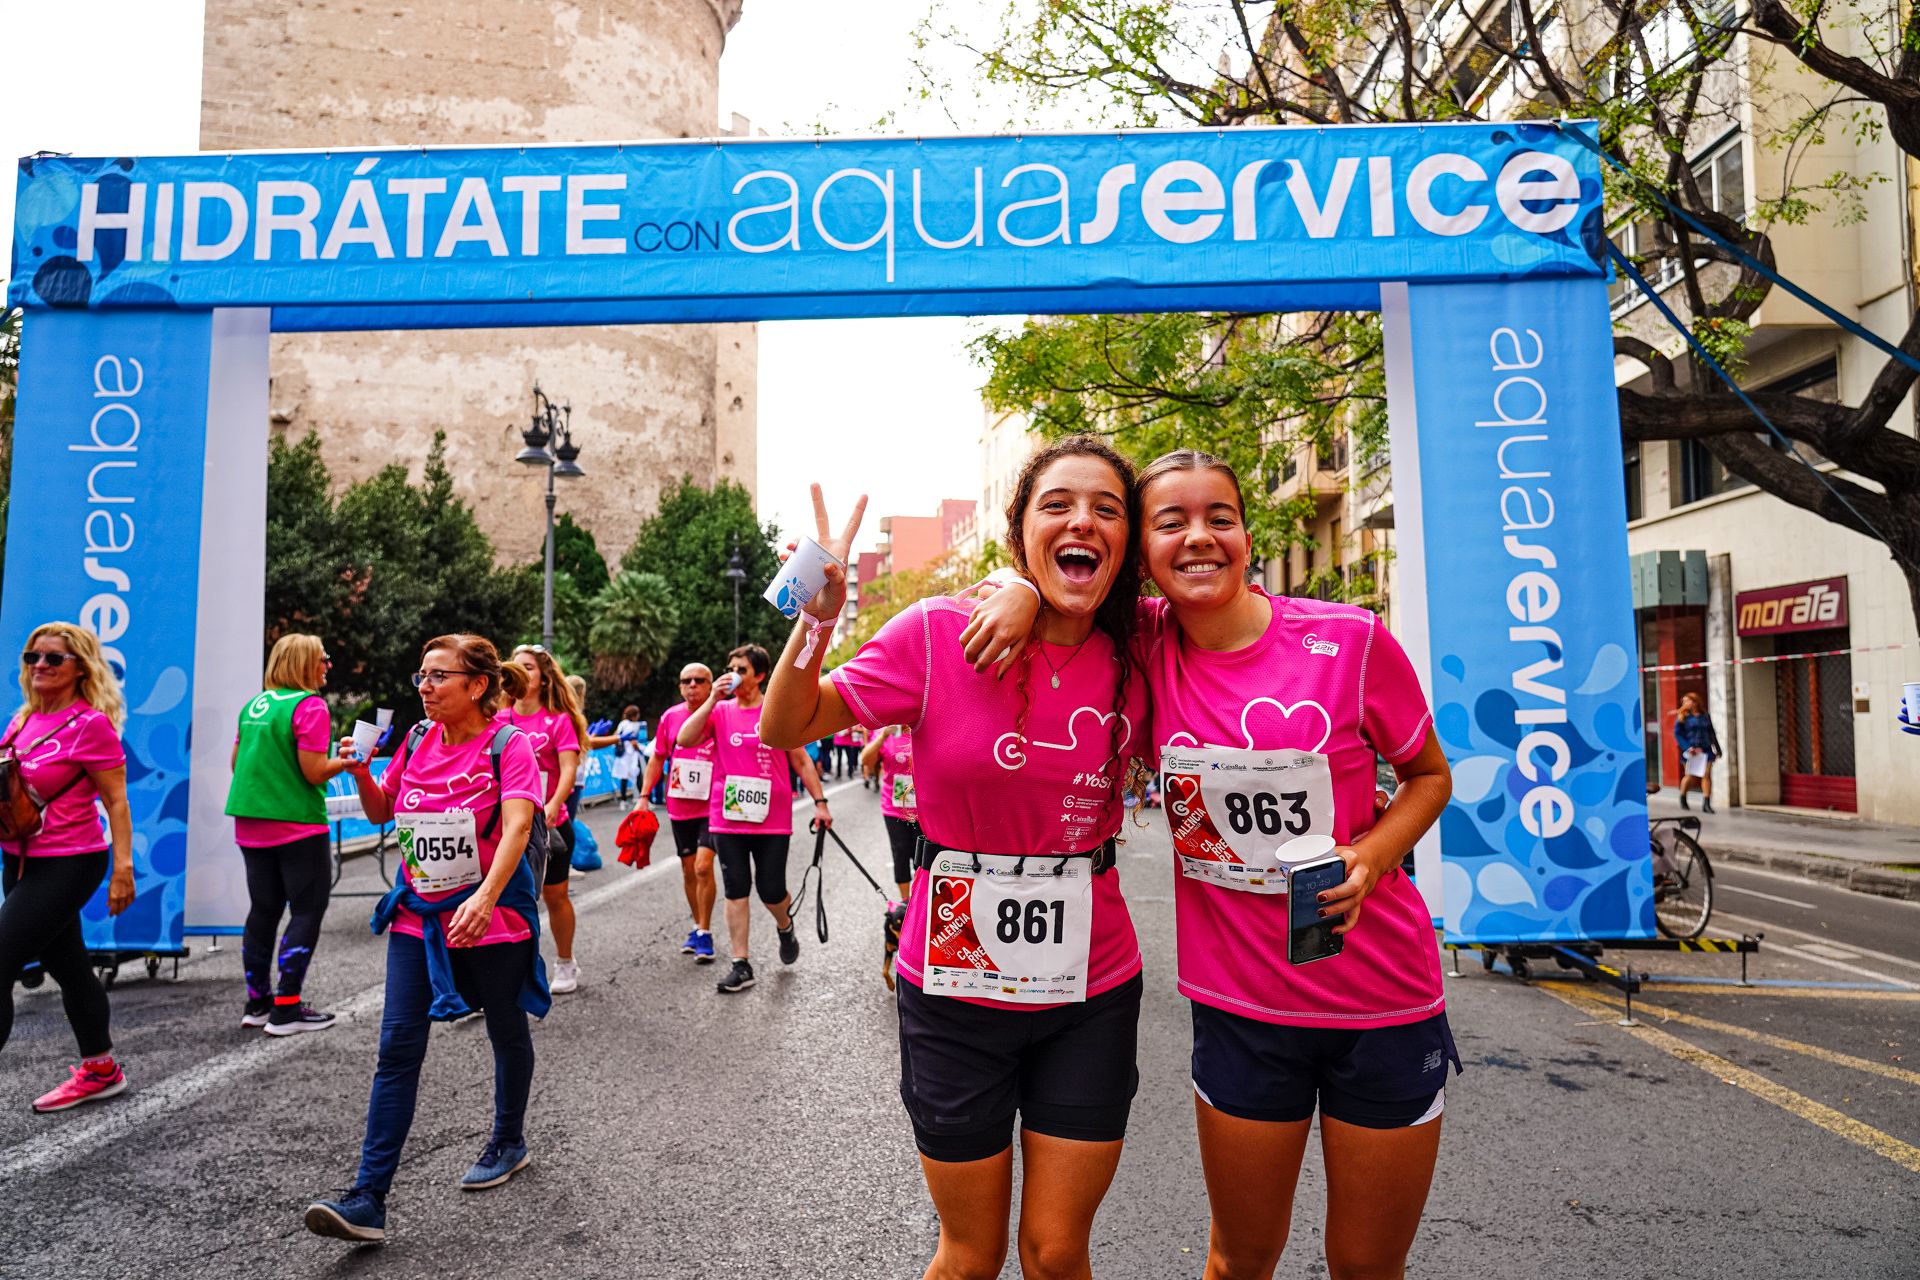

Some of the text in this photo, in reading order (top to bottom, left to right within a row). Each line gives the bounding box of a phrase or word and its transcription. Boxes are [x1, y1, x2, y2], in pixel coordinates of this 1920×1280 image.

[76, 152, 1581, 282] HIDRÁTATE CON aquaservice
[1475, 327, 1575, 838] aquaservice
[689, 771, 700, 783] 51
[738, 789, 767, 805] 6605
[1224, 791, 1311, 836] 863
[1173, 807, 1207, 840] VALÈNCIA
[416, 836, 474, 861] 0554
[930, 912, 971, 948] VALÈNCIA
[996, 898, 1065, 944] 861
